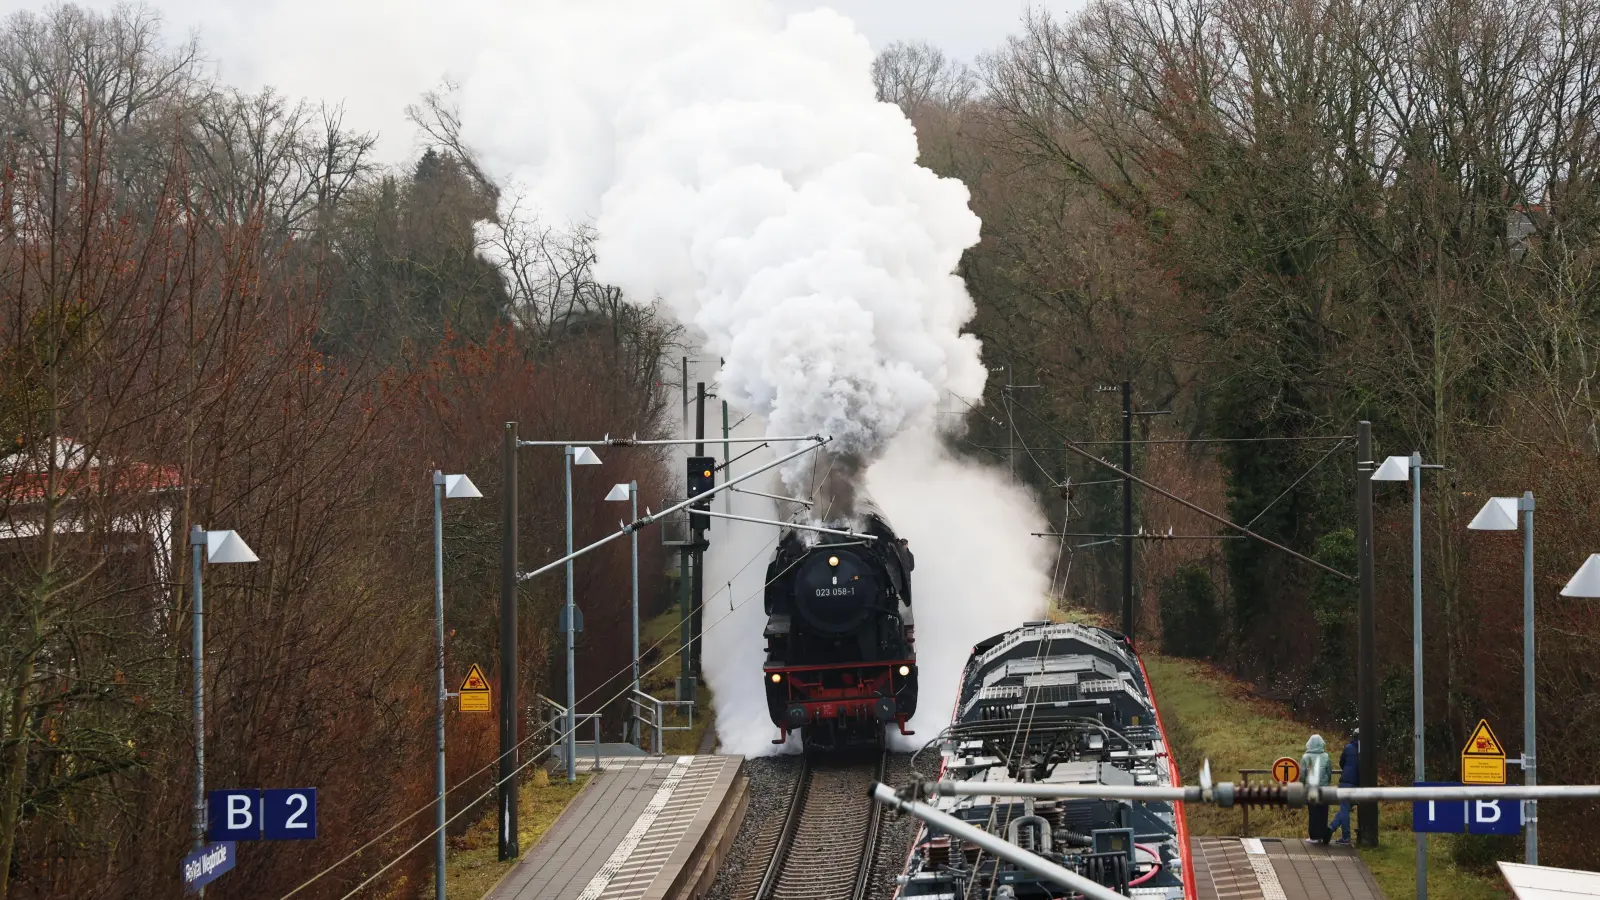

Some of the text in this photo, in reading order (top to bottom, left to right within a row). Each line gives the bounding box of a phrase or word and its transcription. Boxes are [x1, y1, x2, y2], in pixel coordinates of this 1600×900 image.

[815, 587, 855, 597] 023 058-1
[227, 793, 308, 830] B 2
[1475, 799, 1502, 823] B
